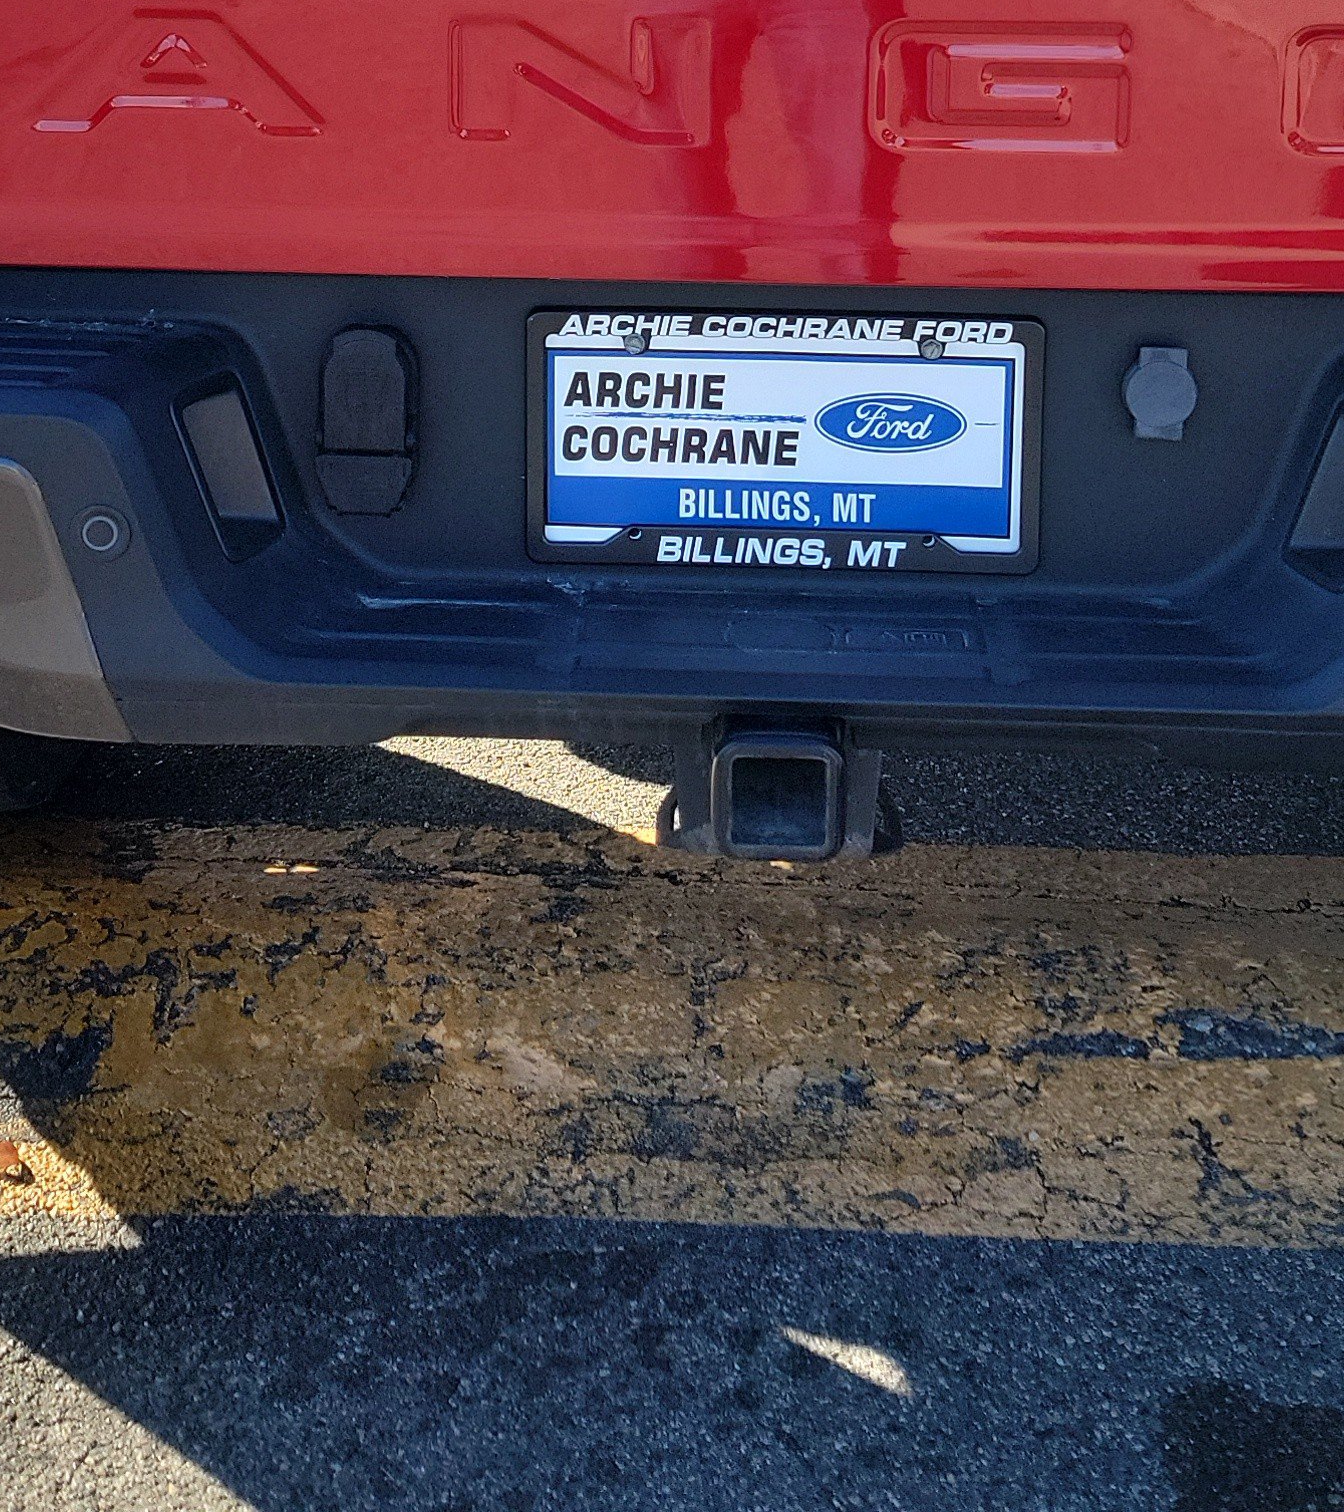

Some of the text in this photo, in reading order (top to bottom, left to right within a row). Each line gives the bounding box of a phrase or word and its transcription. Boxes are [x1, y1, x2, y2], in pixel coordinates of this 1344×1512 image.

[558, 313, 1015, 345] ARCHIE COCHRANE FORD
[563, 370, 727, 412] ARCHIE
[845, 401, 934, 442] Ford
[561, 424, 801, 468] COCHRANE
[678, 488, 877, 526] BILLINGS, MT
[656, 535, 908, 570] BILLINGS, MT
